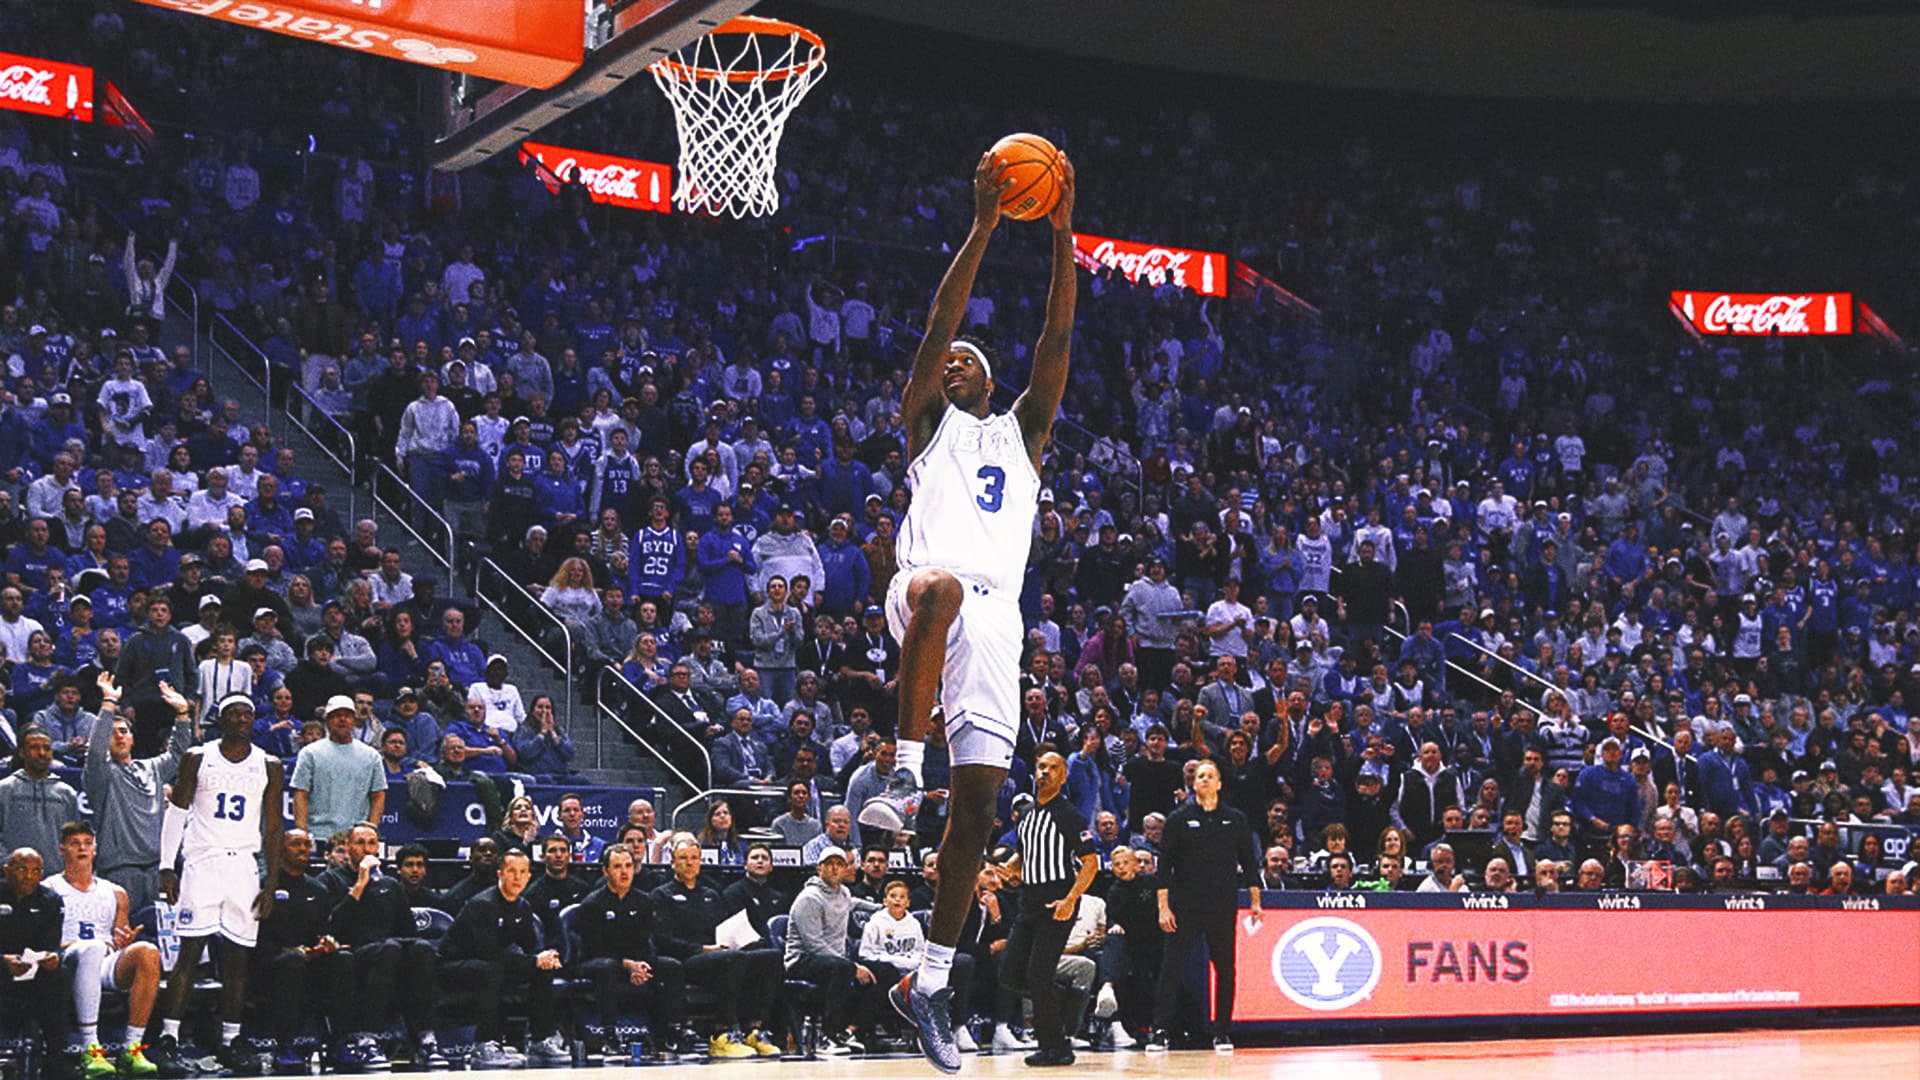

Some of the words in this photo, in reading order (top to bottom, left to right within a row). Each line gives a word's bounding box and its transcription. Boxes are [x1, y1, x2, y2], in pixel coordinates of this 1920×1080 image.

[1704, 295, 1813, 333] Coca-Cola
[613, 480, 627, 493] 13
[976, 464, 1006, 513] 3
[642, 541, 674, 554] BYU
[643, 556, 668, 575] 25
[213, 793, 246, 821] 13
[1407, 941, 1530, 983] FANS
